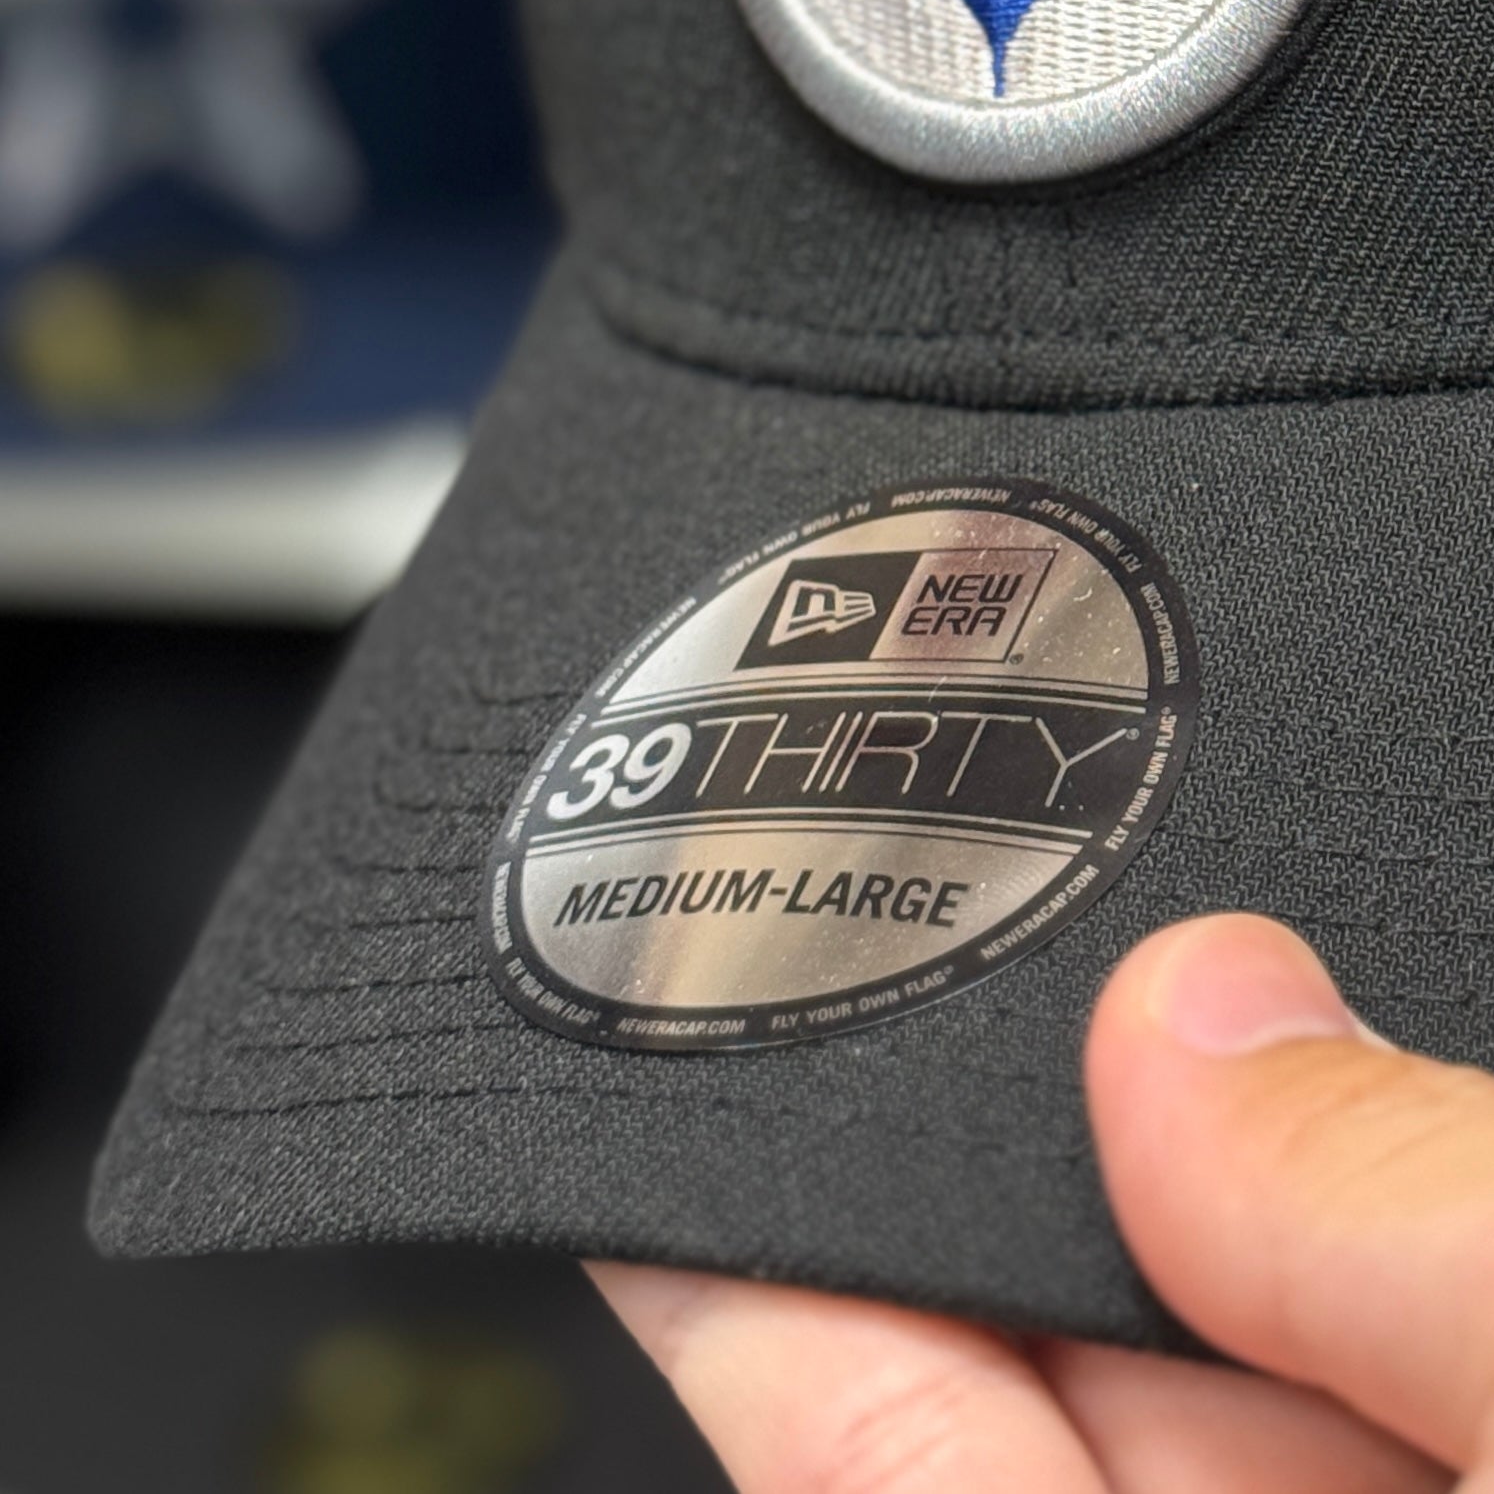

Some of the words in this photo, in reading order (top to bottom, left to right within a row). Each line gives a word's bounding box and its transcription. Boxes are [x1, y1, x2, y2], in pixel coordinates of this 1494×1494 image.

[916, 574, 1023, 604] NEW
[901, 606, 1007, 637] ERA
[1104, 824, 1130, 852] FLY
[1121, 786, 1154, 824] YOUR
[1142, 750, 1169, 785] OWN
[553, 868, 970, 928] MEDIUM-LARGE
[979, 863, 1100, 961] NEWERACAP.COM
[615, 1017, 746, 1036] NEWERACAP.COM
[771, 1011, 800, 1031] FLY
[806, 1001, 853, 1025] YOUR
[858, 987, 900, 1012] OWN
